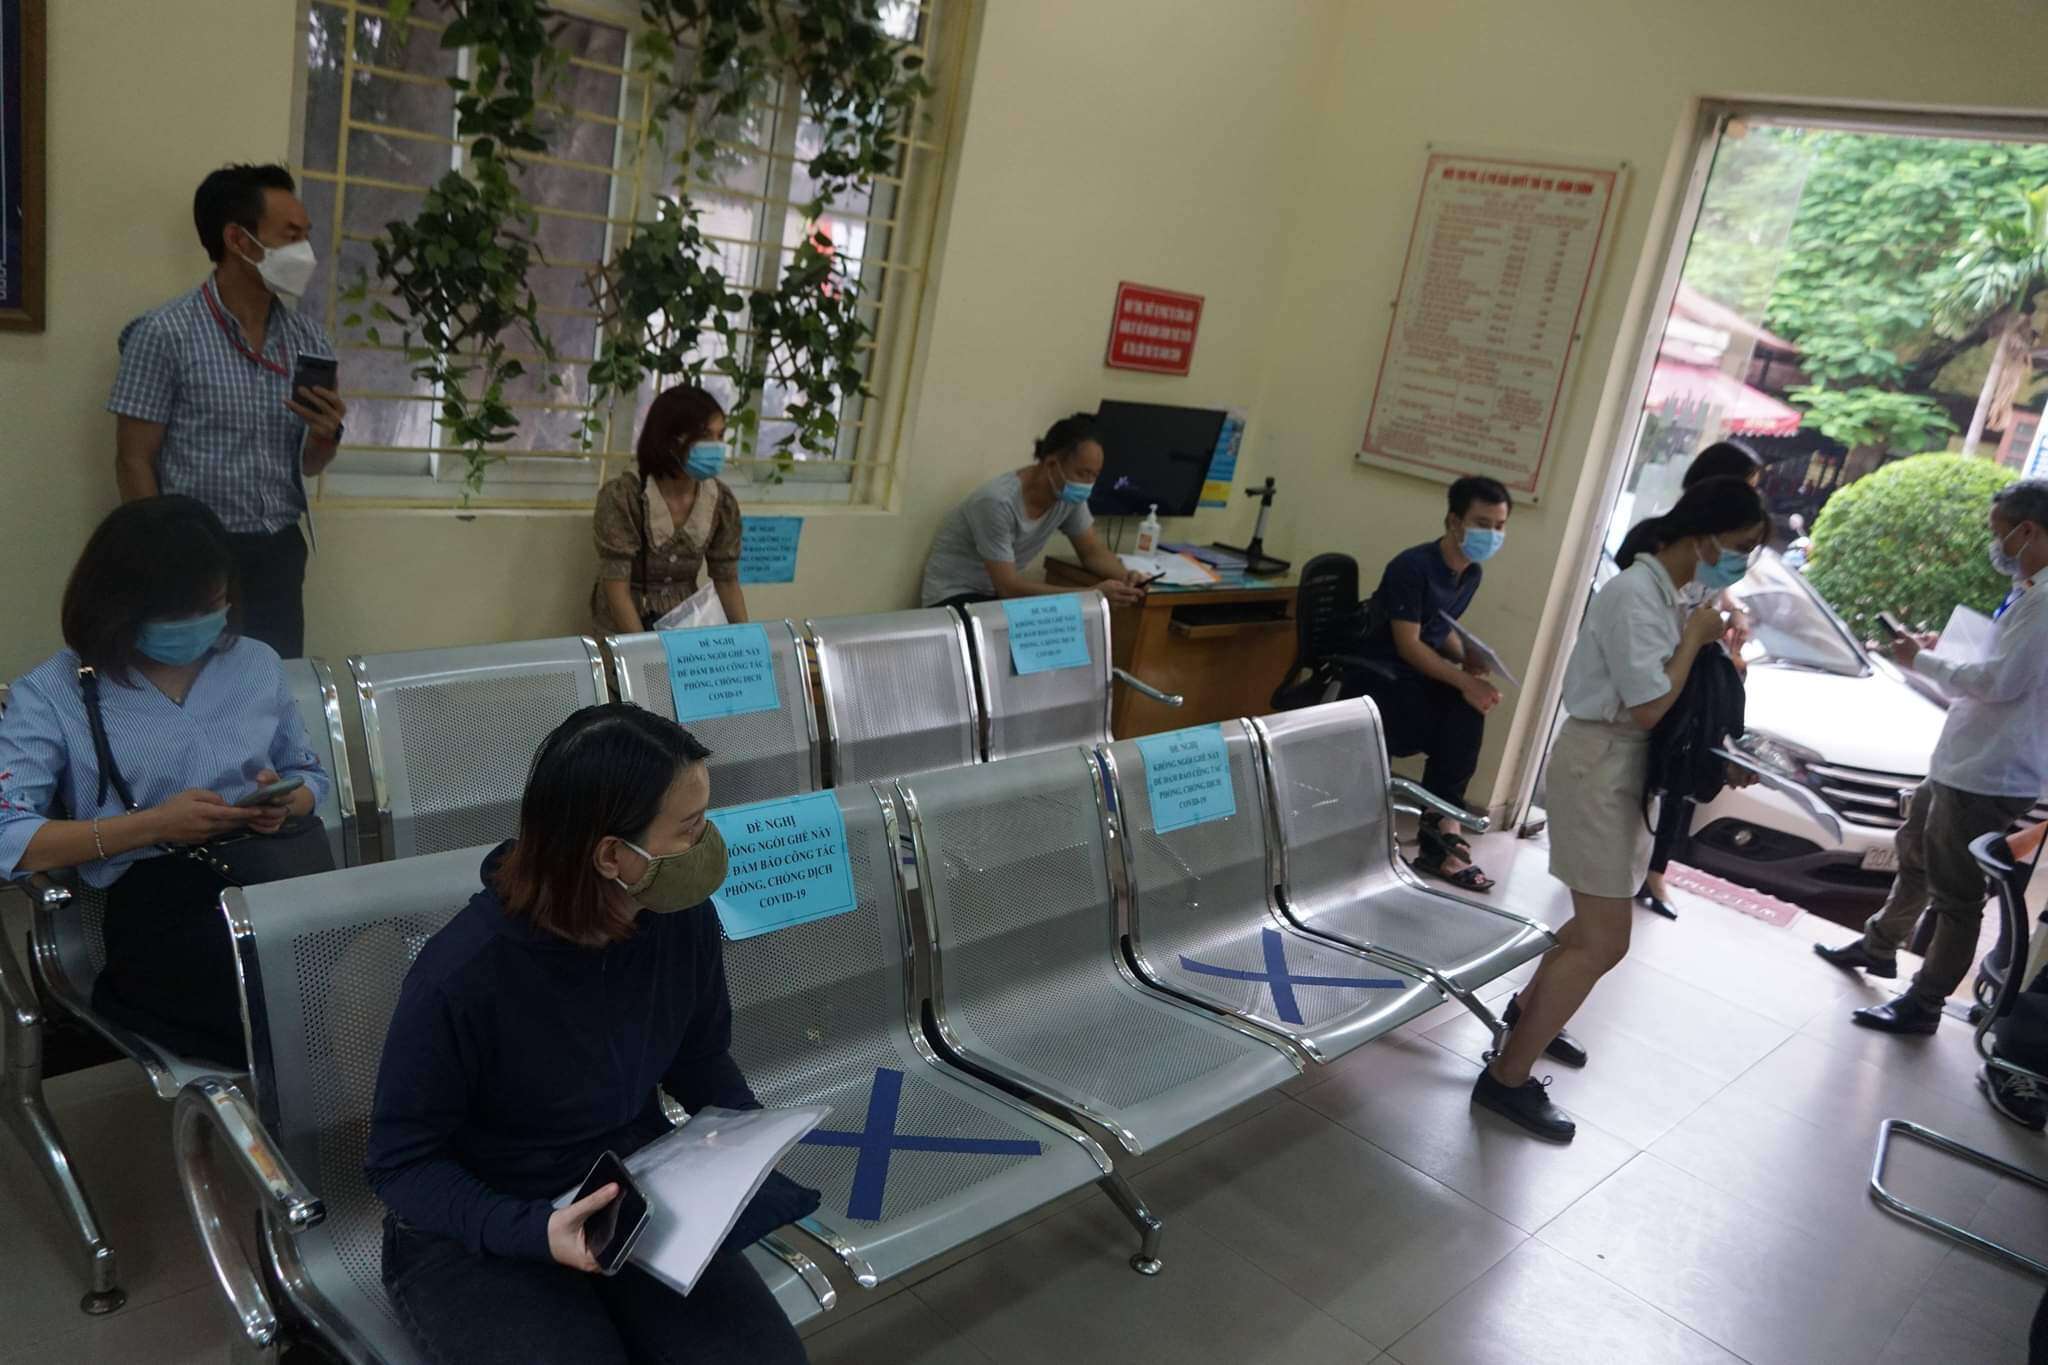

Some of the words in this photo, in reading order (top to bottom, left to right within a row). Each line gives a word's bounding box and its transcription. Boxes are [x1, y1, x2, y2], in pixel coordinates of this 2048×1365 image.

[765, 815, 796, 829] NGHỊ
[758, 835, 785, 851] NGỒI
[787, 829, 809, 845] GHẾ
[811, 826, 832, 839] NÀY
[760, 855, 782, 870] BẢO
[784, 850, 814, 865] CÔNG
[816, 843, 836, 857] TÁC
[767, 870, 806, 888] CHỐNG
[807, 863, 833, 880] DỊCH
[759, 888, 807, 908] COVID-19
